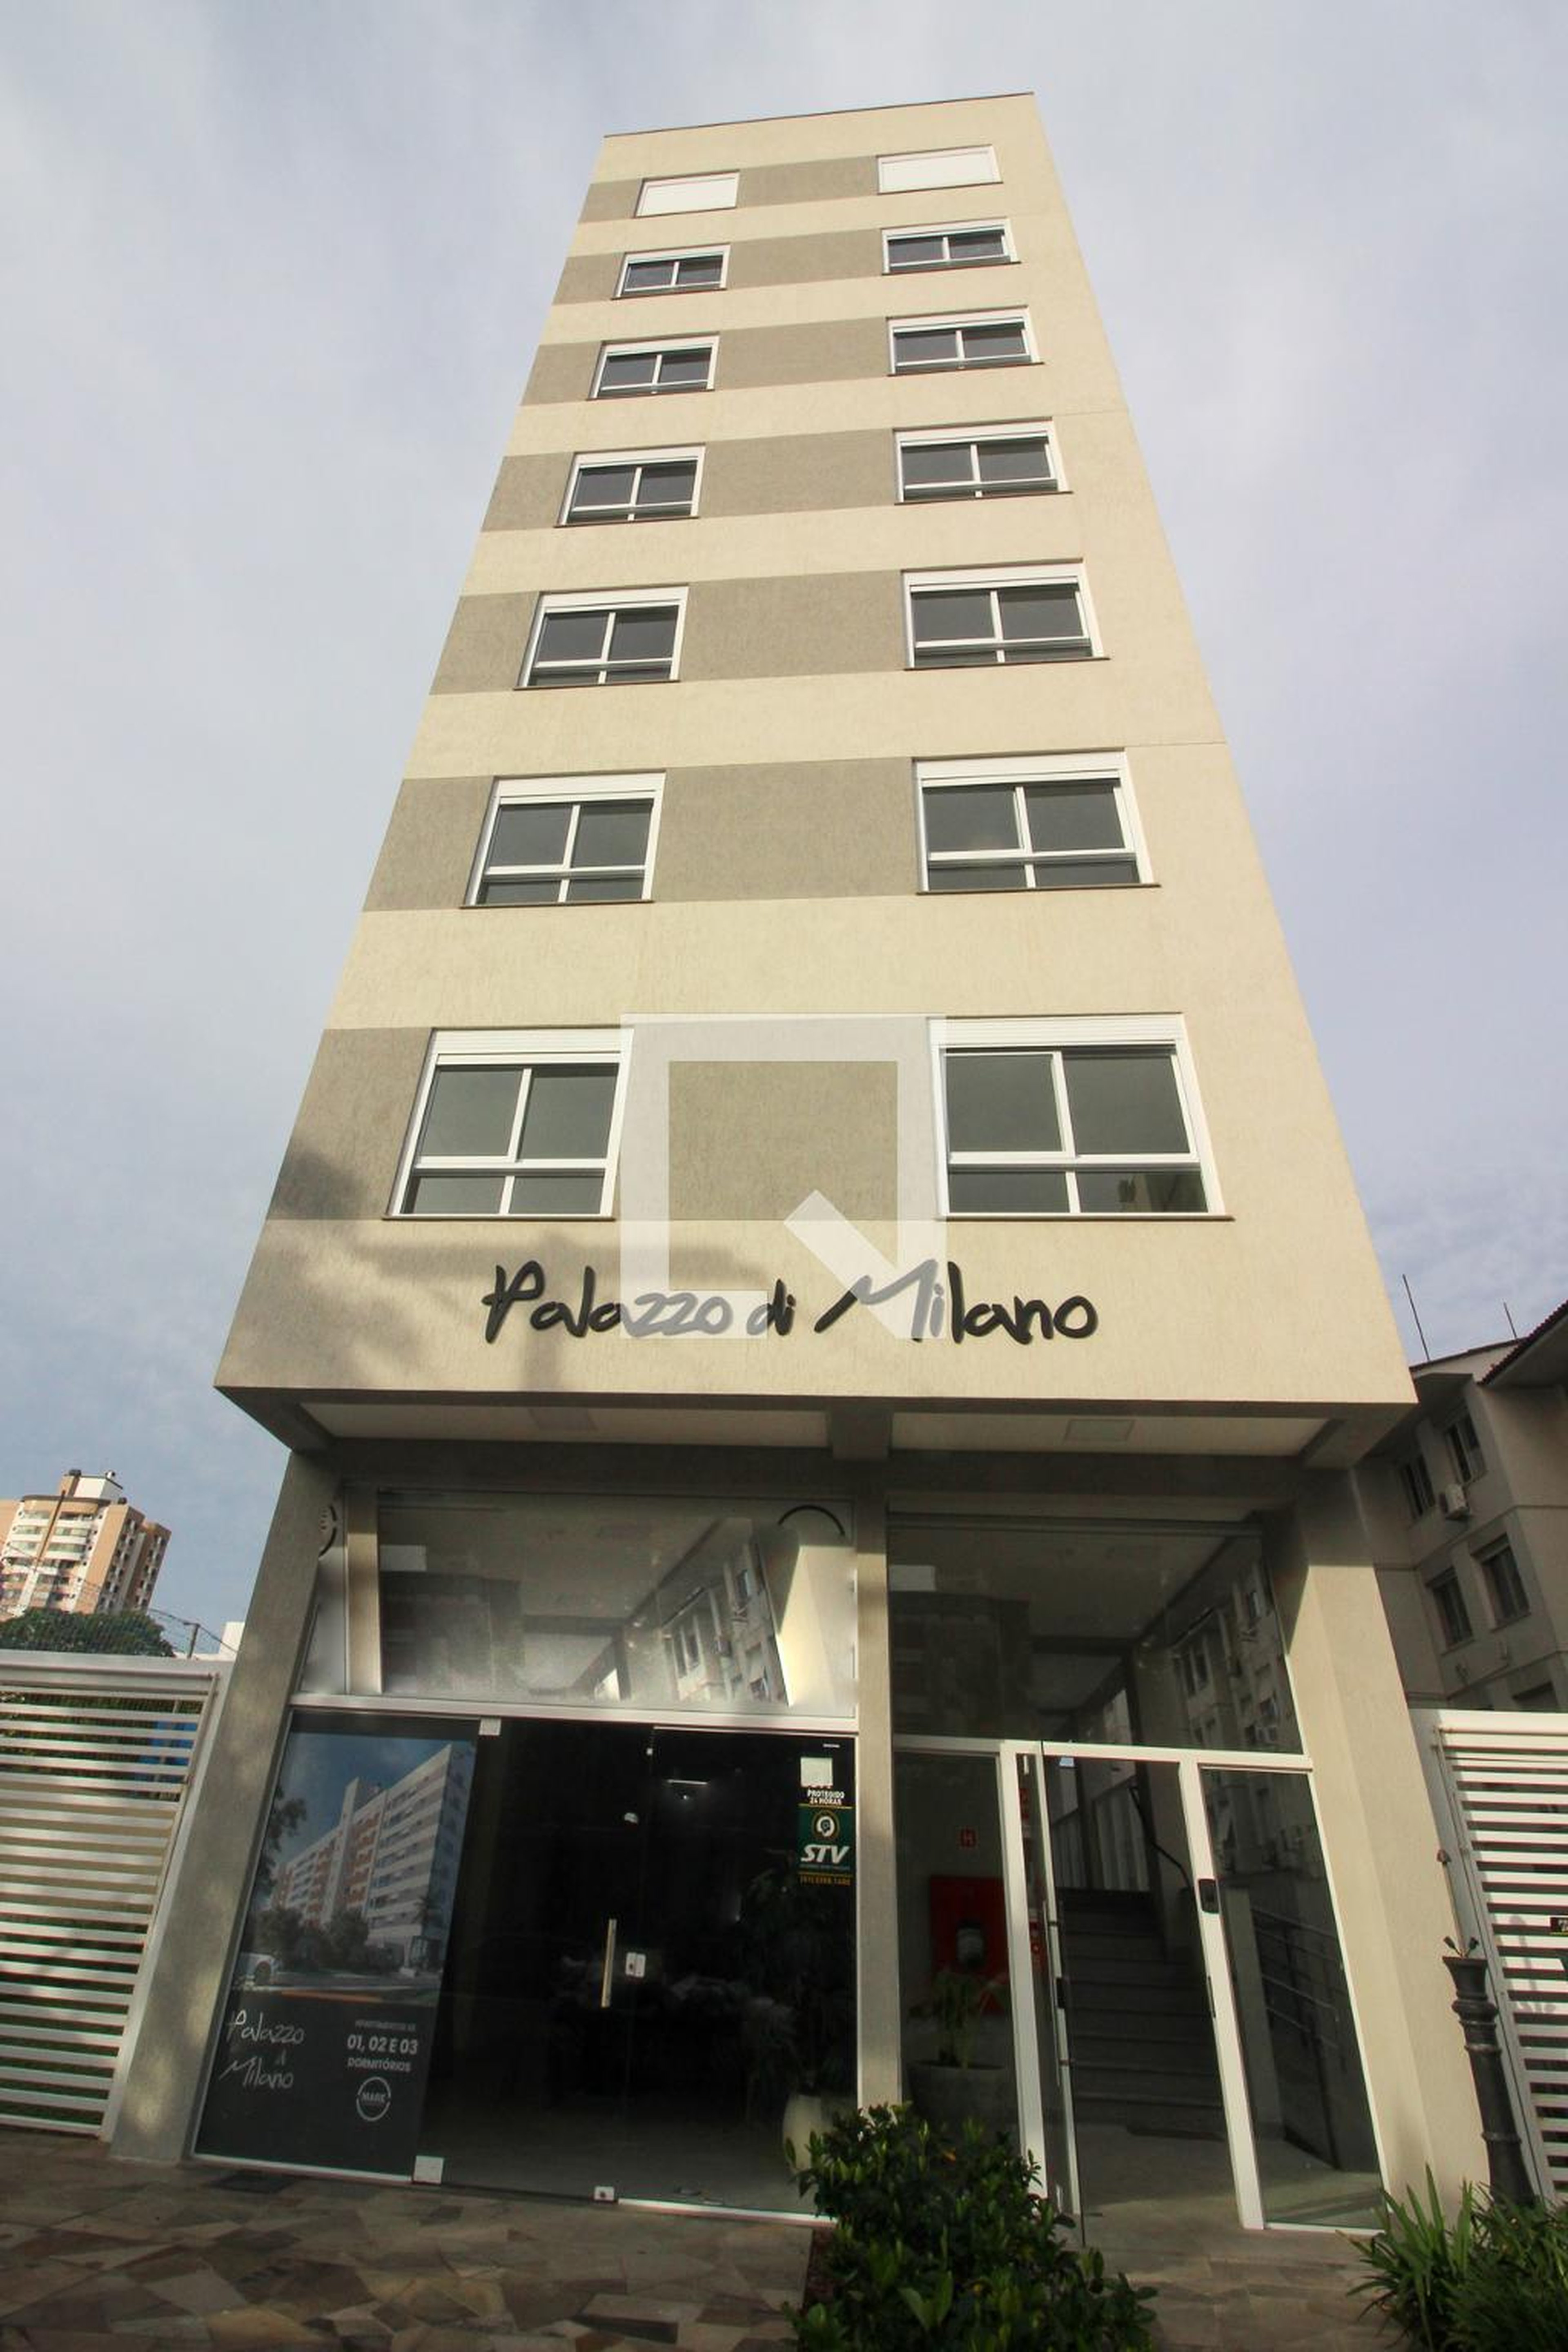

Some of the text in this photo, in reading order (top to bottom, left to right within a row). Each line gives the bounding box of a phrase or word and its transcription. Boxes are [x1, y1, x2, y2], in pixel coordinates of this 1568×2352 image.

[483, 1258, 1098, 1343] Palazzo di Milano
[800, 1844, 850, 1864] STV
[226, 2009, 305, 2045] Palazzo
[347, 2034, 419, 2055] 01, 02 E 03
[218, 2056, 294, 2089] Milano
[347, 2057, 412, 2073] DORMITÓRIOS
